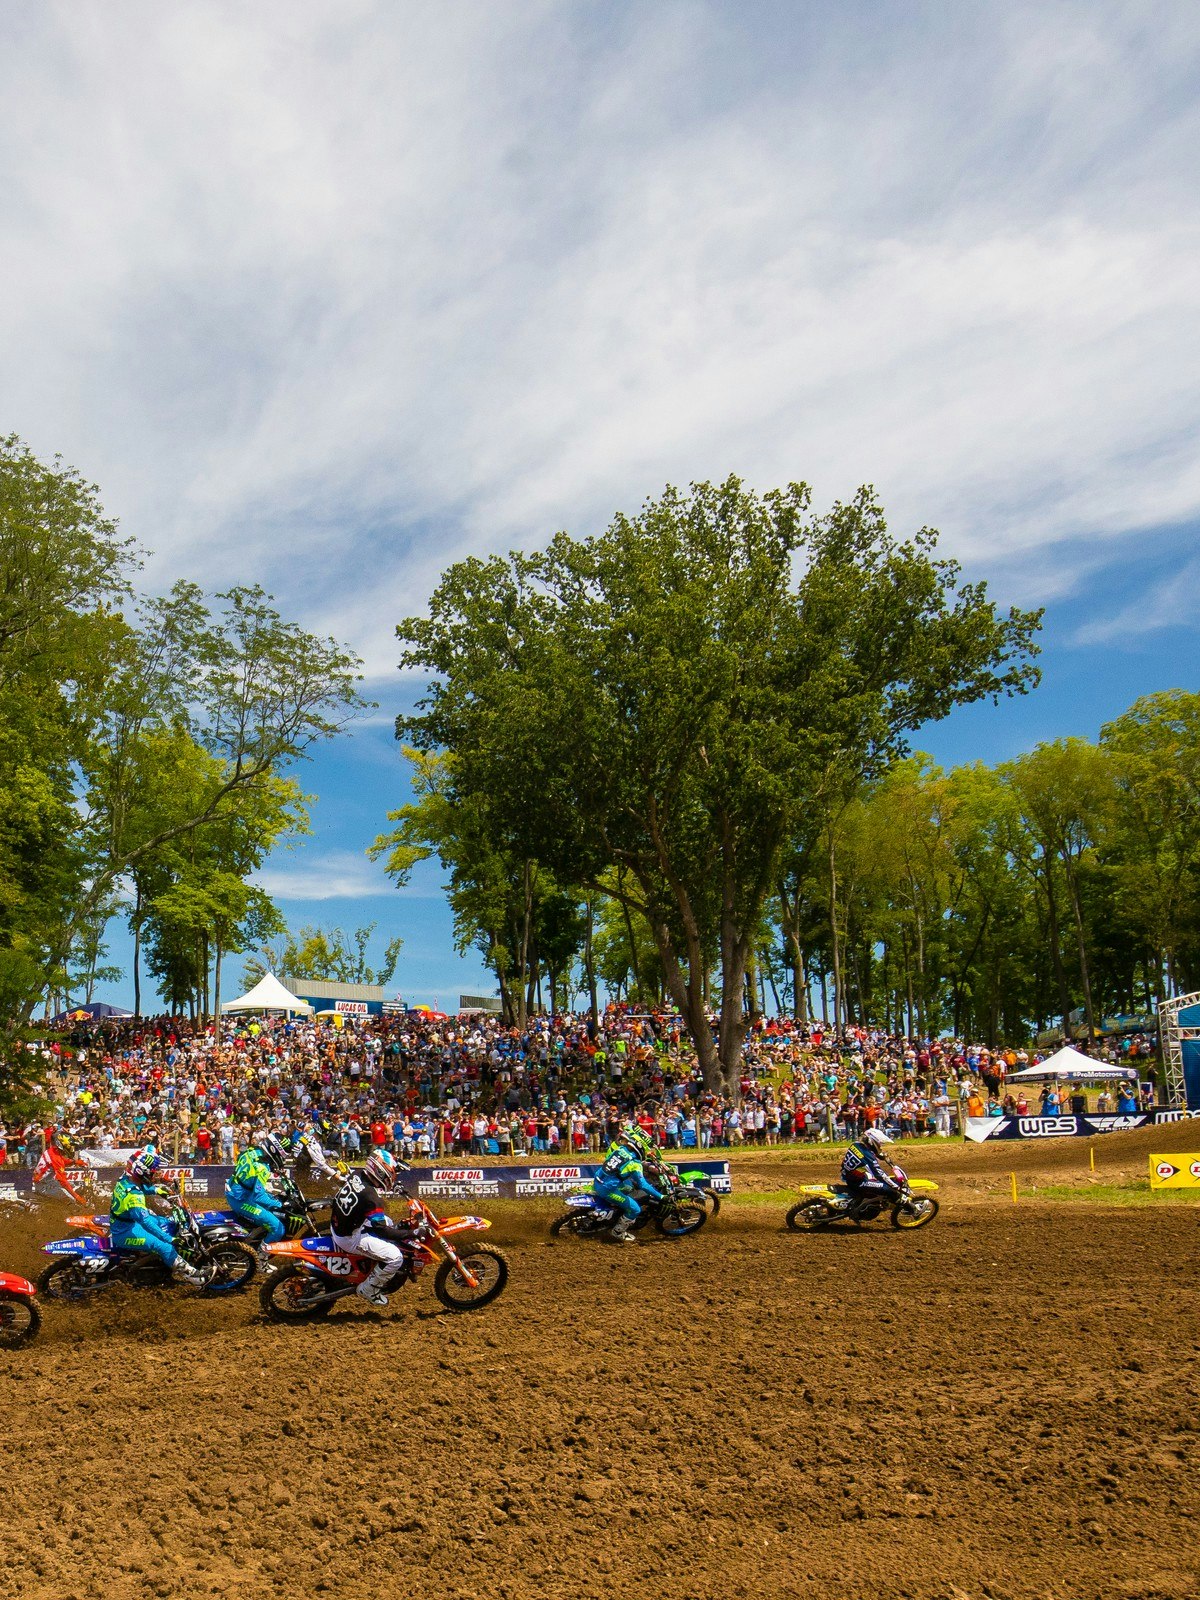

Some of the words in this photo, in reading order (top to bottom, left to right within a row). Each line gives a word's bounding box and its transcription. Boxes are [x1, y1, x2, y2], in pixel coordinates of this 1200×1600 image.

[337, 1003, 356, 1013] LUCAS
[357, 1004, 367, 1013] OIL
[1018, 1116, 1078, 1137] WPS
[435, 1170, 465, 1180] LUCAS
[467, 1170, 481, 1179] OIL
[532, 1168, 562, 1178] LUCAS
[564, 1168, 579, 1177] OIL
[418, 1184, 499, 1195] MOTOCROSS
[85, 1258, 110, 1274] 32
[326, 1256, 352, 1275] 123
